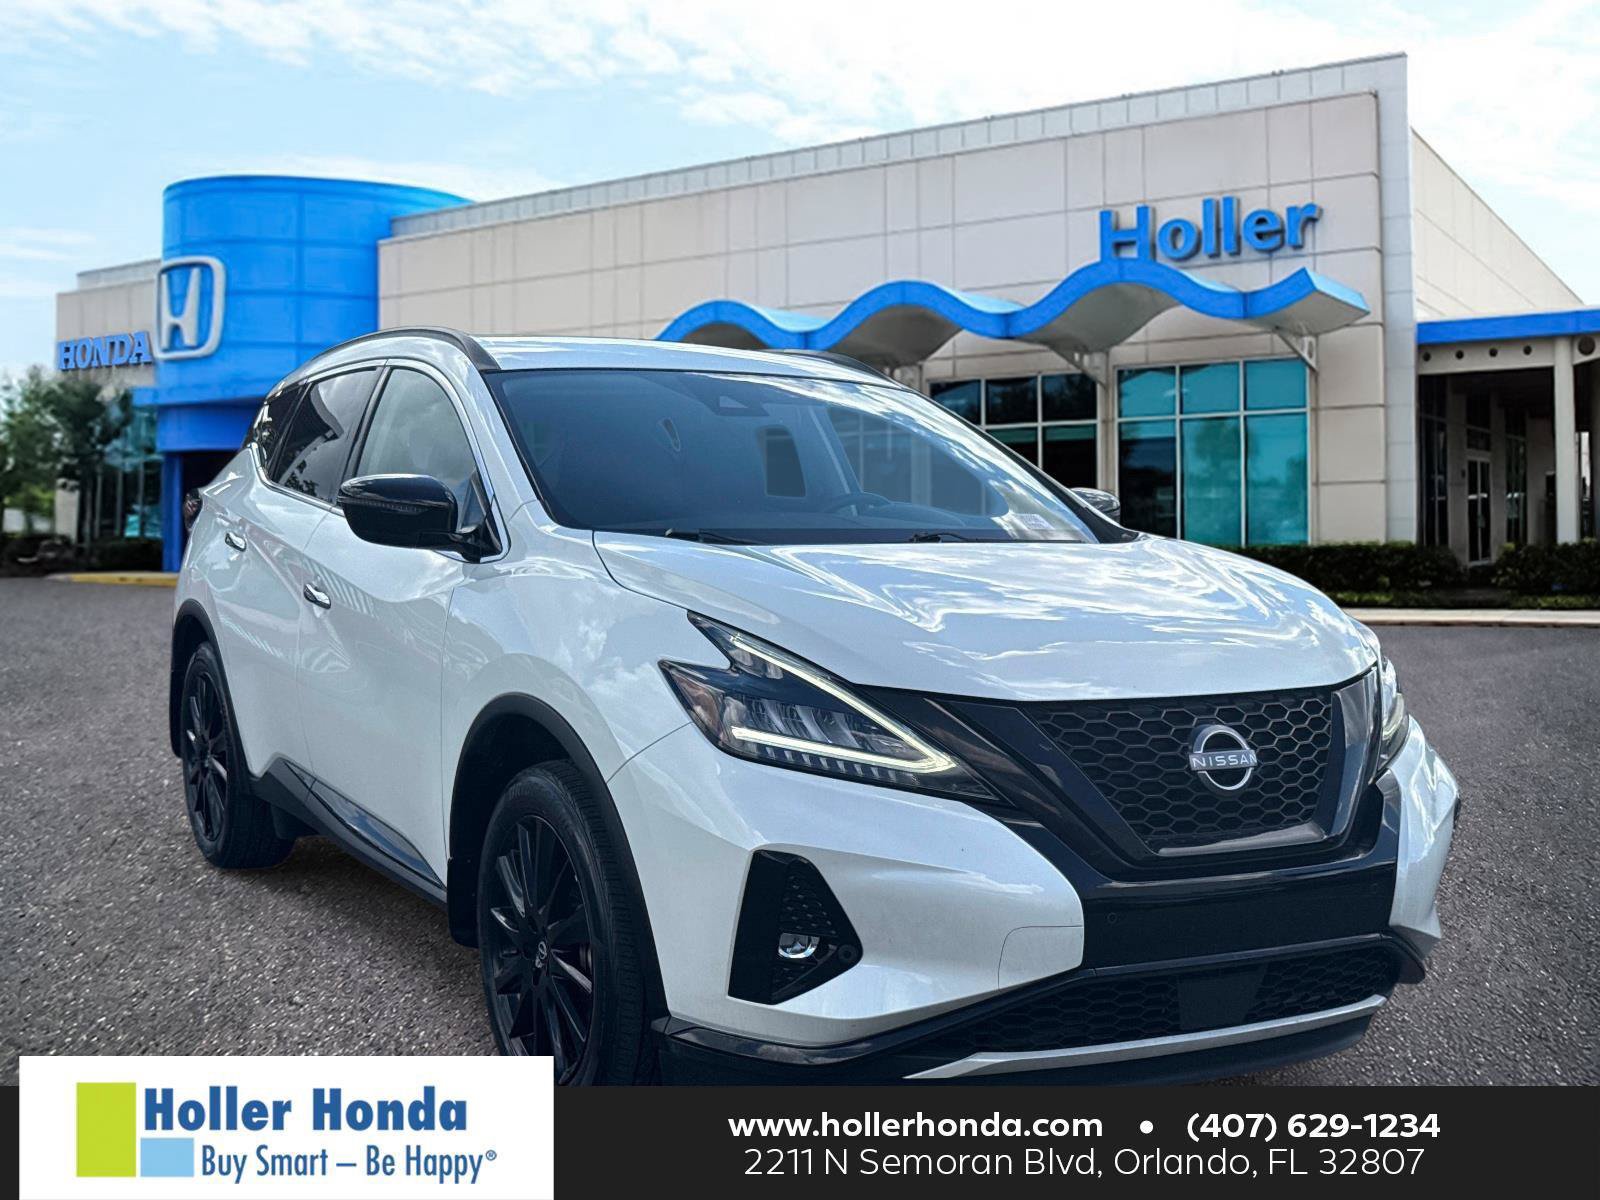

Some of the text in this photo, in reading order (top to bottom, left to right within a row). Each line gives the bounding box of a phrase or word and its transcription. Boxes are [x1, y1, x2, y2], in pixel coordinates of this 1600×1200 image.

[1099, 196, 1321, 261] Holler
[57, 331, 153, 371] HONDA
[1191, 754, 1258, 769] NISSAN
